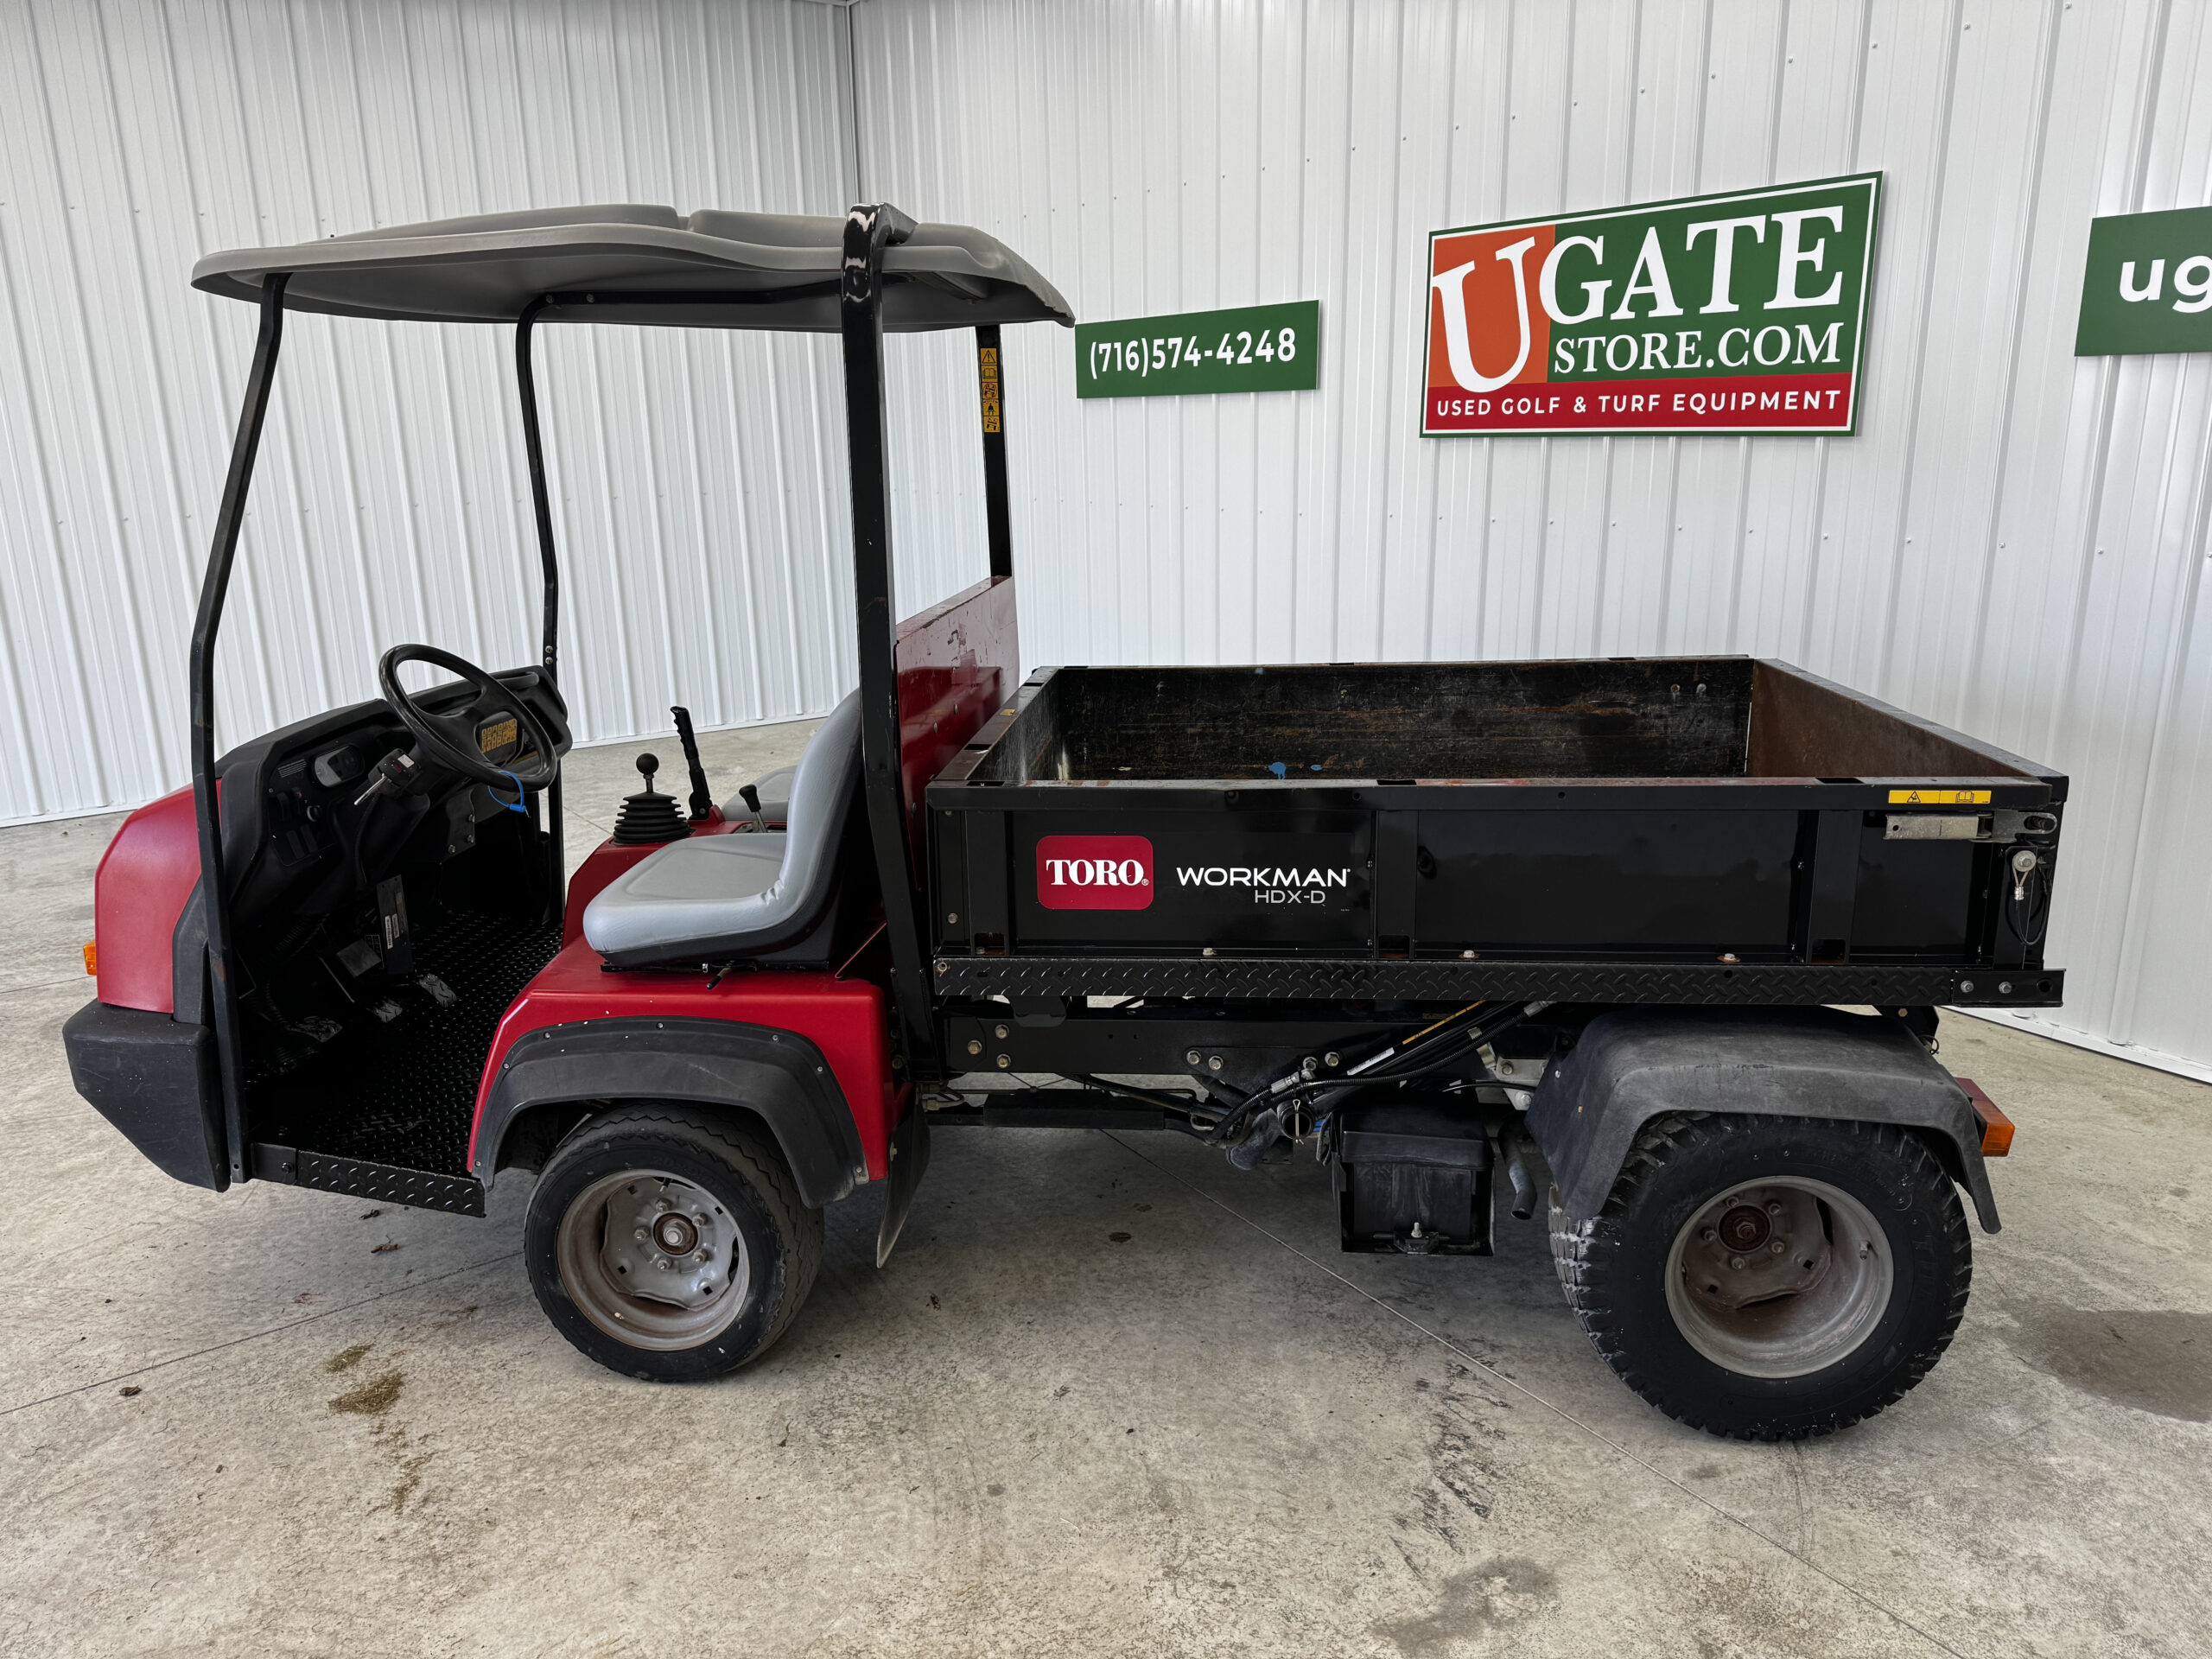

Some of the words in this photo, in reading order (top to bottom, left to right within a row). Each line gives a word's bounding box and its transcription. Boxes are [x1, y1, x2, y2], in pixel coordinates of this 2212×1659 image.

[1090, 327, 1296, 380] (716)574-4248
[1553, 321, 1845, 374] STORE.COM
[1437, 398, 1491, 416] USED
[1501, 397, 1560, 415] GOLF
[1573, 396, 1586, 414] &
[1598, 394, 1661, 413] TURF
[1673, 390, 1841, 415] EQUIPMENT
[1176, 867, 1347, 887] WORKMAN
[1255, 889, 1326, 904] HDX-D
